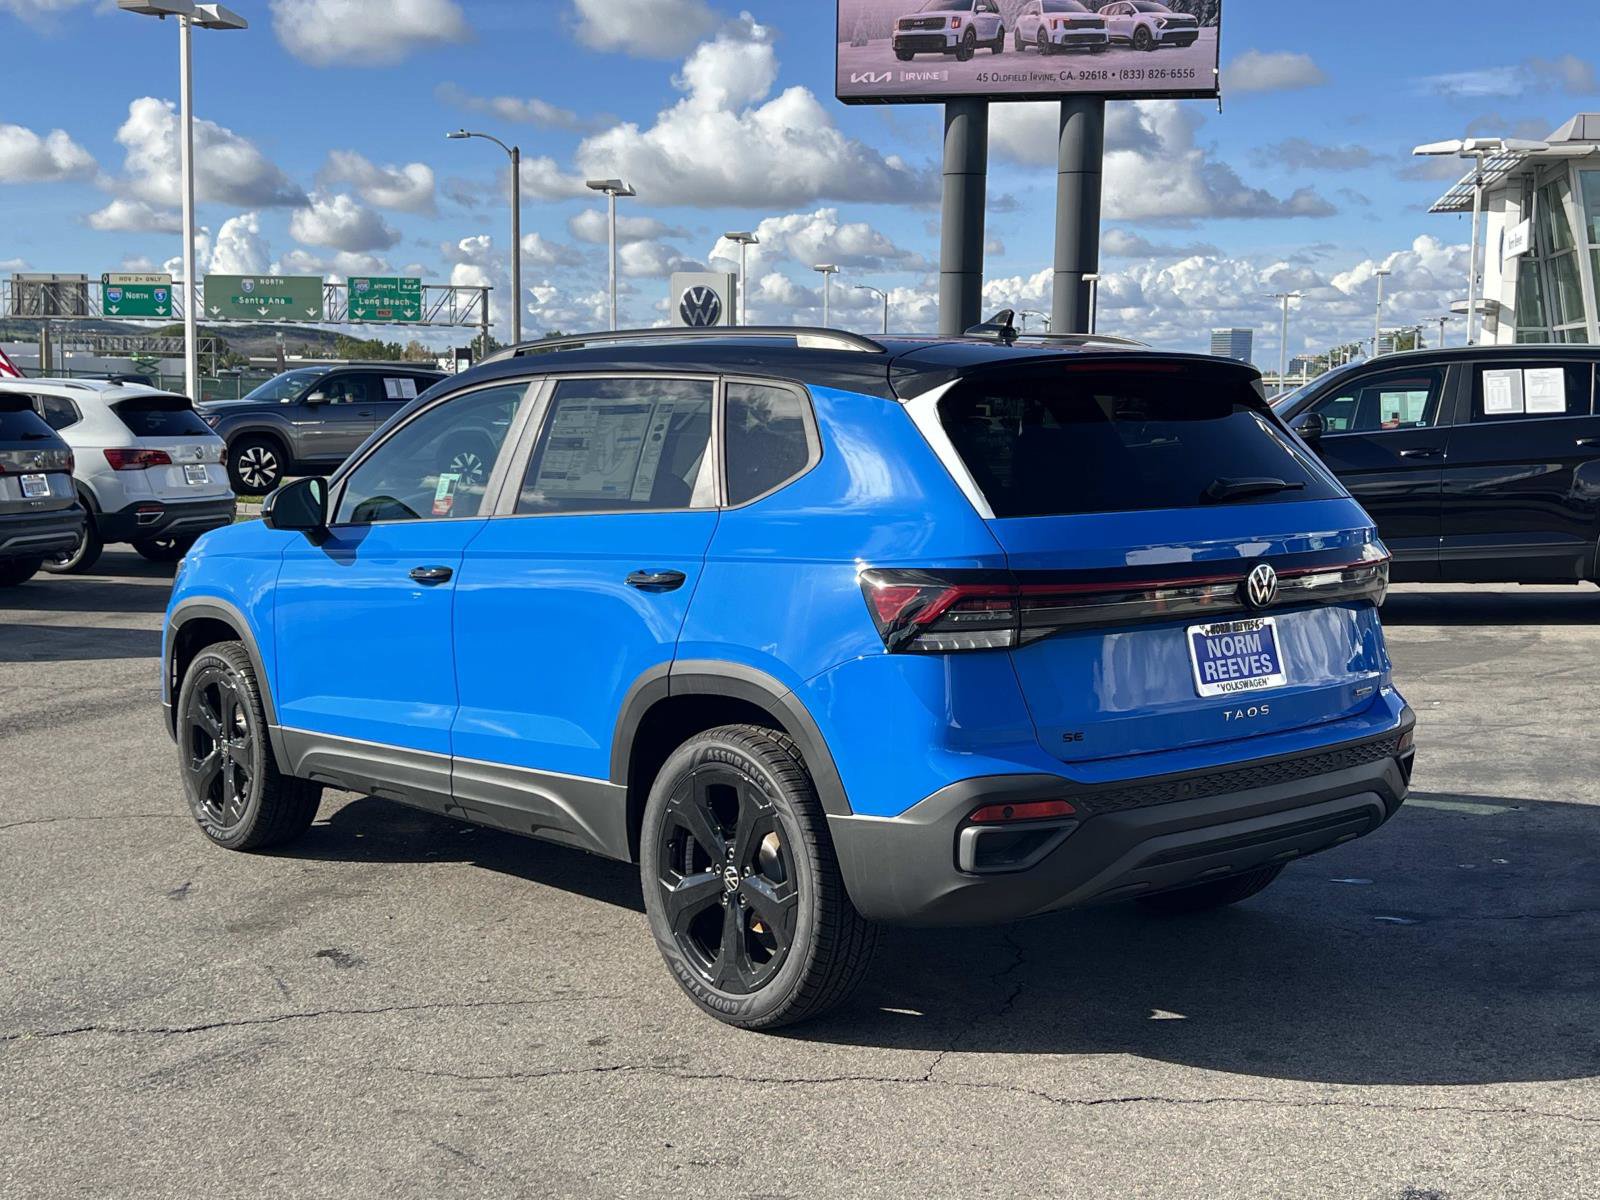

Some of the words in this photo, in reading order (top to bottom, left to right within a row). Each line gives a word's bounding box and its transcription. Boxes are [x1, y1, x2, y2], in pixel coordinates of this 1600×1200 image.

[850, 71, 892, 83] KIA
[905, 71, 940, 81] IRVINE
[976, 73, 988, 82] 45
[1059, 71, 1076, 81] CA.
[1079, 70, 1108, 81] 92618
[1119, 69, 1145, 80] (833)
[1148, 68, 1196, 79] 826-6556
[238, 296, 265, 305] Santa
[268, 297, 285, 305] Ana
[358, 297, 380, 307] Long
[383, 297, 410, 306] Beach
[1206, 633, 1262, 659] NORM
[1203, 653, 1274, 681] REEVES
[1223, 704, 1270, 722] TAOS
[1062, 731, 1085, 743] SE
[707, 749, 772, 793] ASSURANCE
[673, 961, 739, 1014] GOODYEAR
